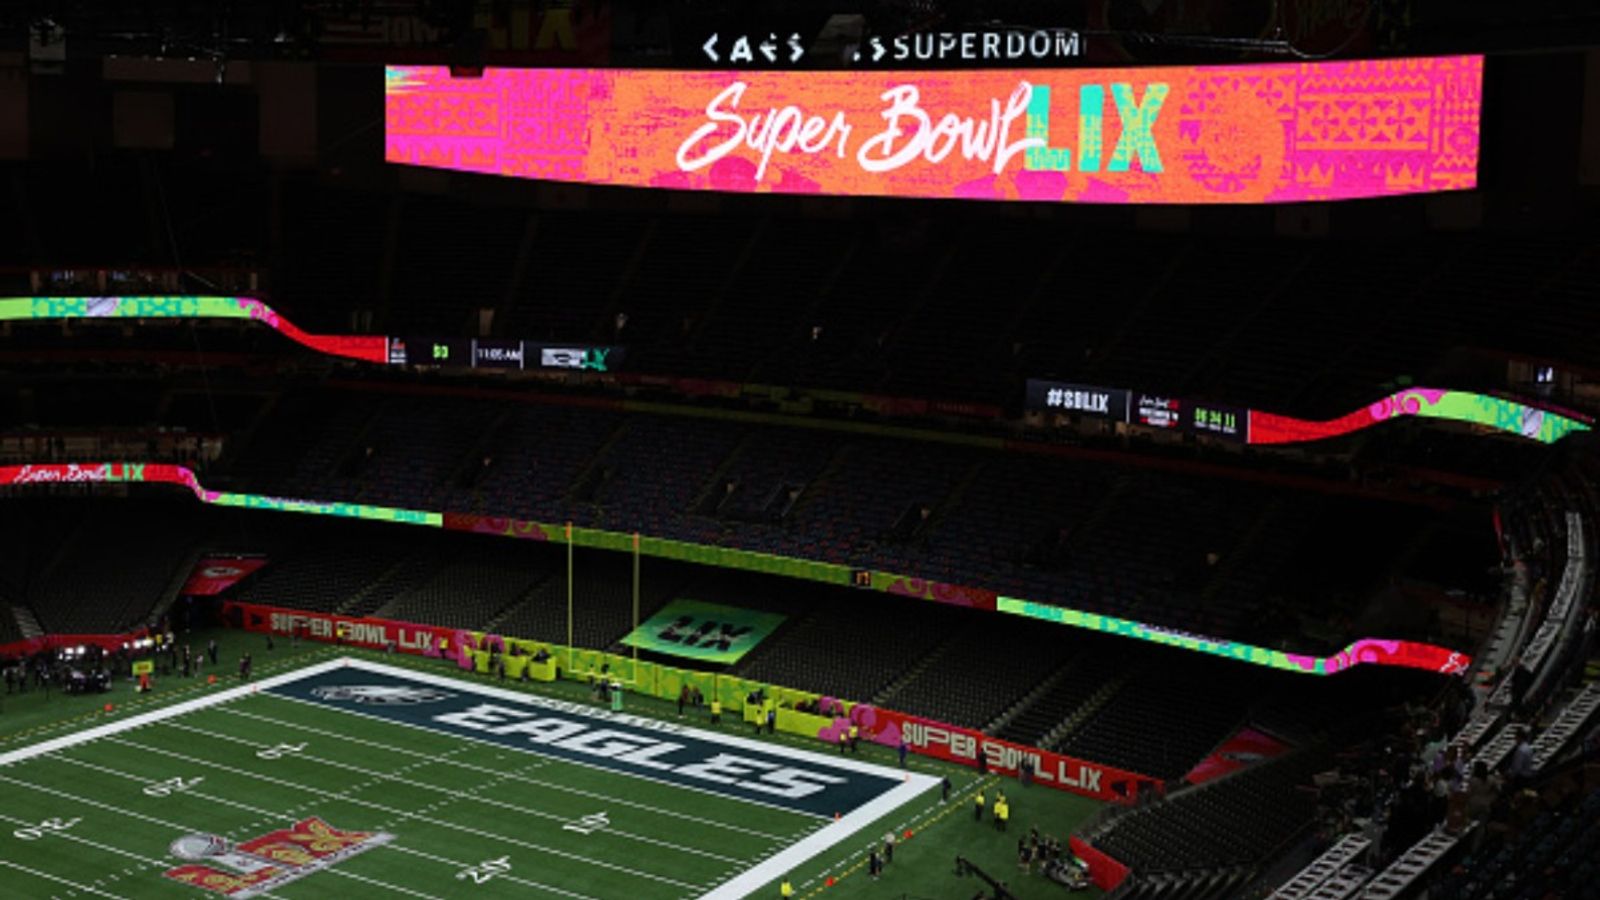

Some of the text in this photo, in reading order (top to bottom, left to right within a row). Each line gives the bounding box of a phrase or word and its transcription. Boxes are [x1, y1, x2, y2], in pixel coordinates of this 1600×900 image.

[676, 81, 854, 181] Super
[1025, 83, 1170, 173] LIX
[1047, 387, 1110, 414] #SBLIX
[104, 462, 145, 482] LIX
[399, 628, 433, 650] LIX
[657, 615, 754, 652] LIX
[431, 703, 849, 799] EAGLES
[901, 720, 977, 760] SUPER
[1058, 760, 1103, 792] LIX
